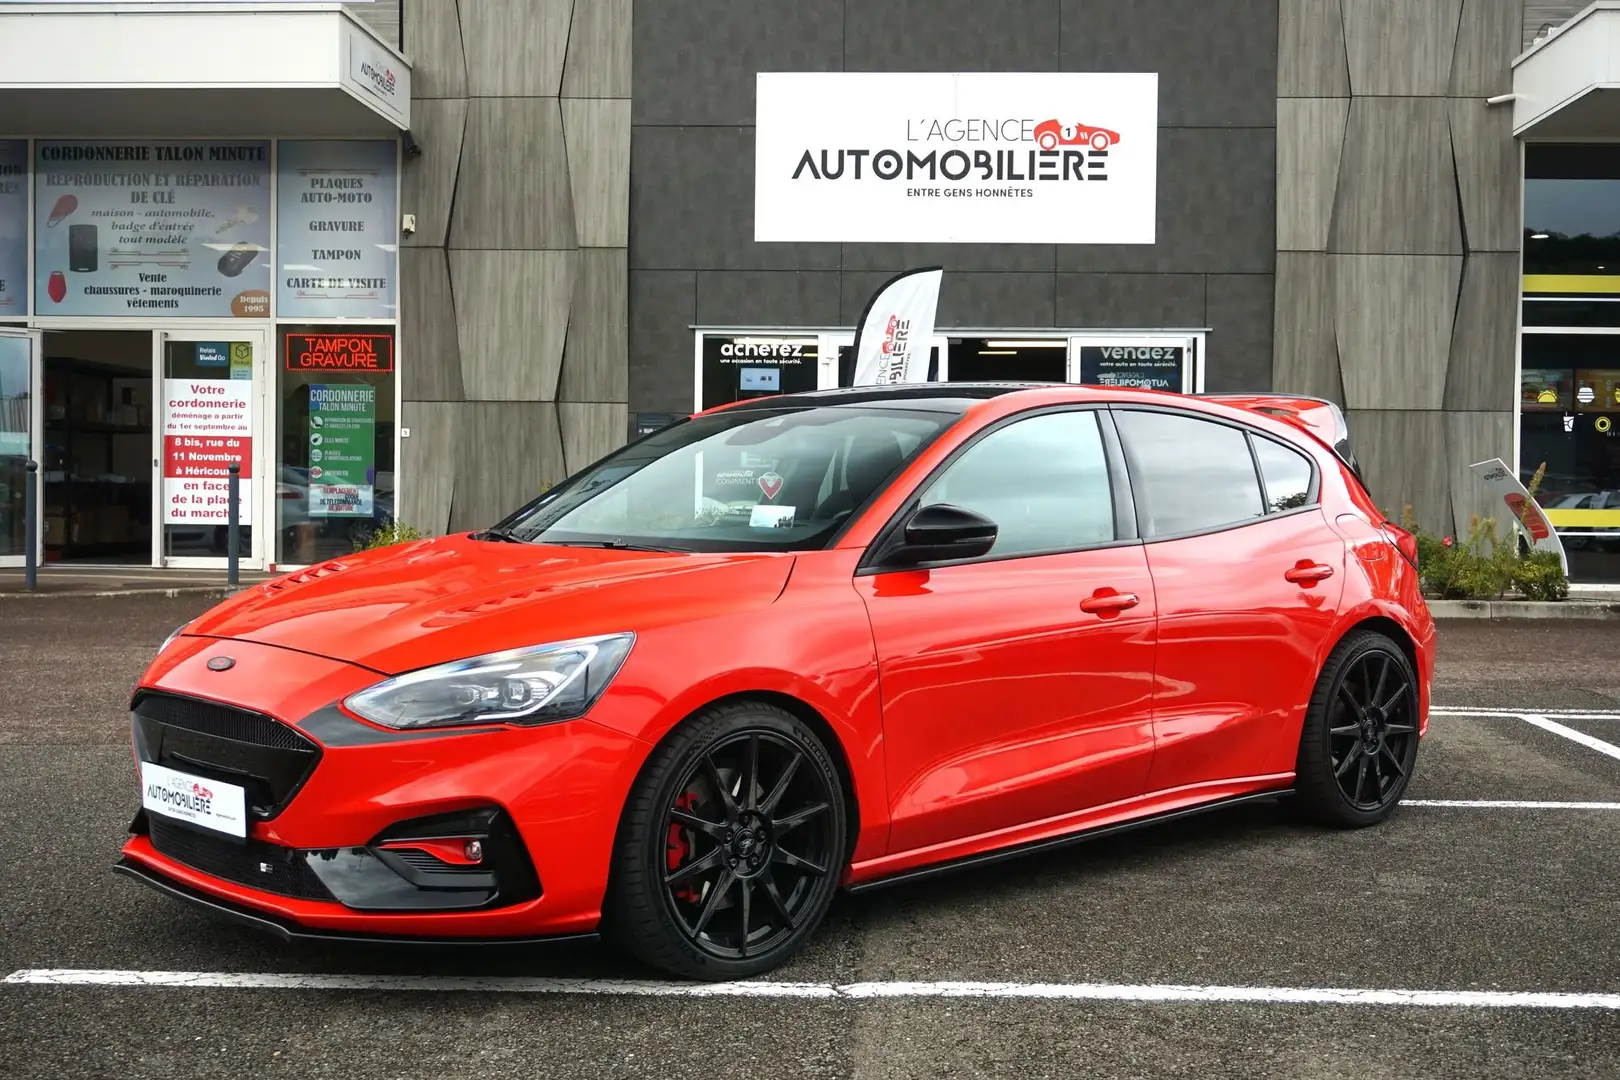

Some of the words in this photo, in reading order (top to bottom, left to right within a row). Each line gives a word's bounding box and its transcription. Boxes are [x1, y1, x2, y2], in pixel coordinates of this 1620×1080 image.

[907, 119, 1034, 142] L'AGENCE
[1065, 127, 1071, 137] 1
[42, 146, 150, 161] CORDONNERIE
[155, 146, 204, 161] TALON
[209, 146, 265, 161] MINUTE
[791, 149, 1108, 181] AUTOMOBILIERE
[46, 173, 150, 187] REPRODUCTION
[155, 173, 170, 187] ET
[175, 171, 260, 187] RÉPARATION
[311, 178, 363, 190] PLAQUES
[130, 191, 149, 204] DE
[153, 189, 175, 204] CLÉ
[907, 188, 941, 197] ENTRE
[944, 188, 973, 197] GENS
[976, 186, 1033, 197] HONNÊTES
[301, 192, 372, 203] AUTO-MOTO
[91, 209, 134, 217] maison
[145, 208, 215, 218] automobile,
[111, 222, 146, 233] badge
[149, 222, 195, 231] d'entrée
[309, 221, 364, 231] GRAVURE
[119, 236, 142, 244] tout
[145, 235, 187, 244] modèle
[312, 250, 361, 260] TAMPON
[139, 273, 167, 282] Vente
[287, 278, 325, 288] CARTE
[328, 278, 344, 288] DE
[348, 278, 386, 288] VISITE
[84, 286, 140, 295] chaussures
[150, 286, 222, 296] maroquinerie
[127, 298, 179, 308] vêtements
[240, 295, 268, 304] Depuis
[305, 338, 372, 352] TAMPON
[720, 337, 802, 357] achetez
[301, 353, 377, 367] GRAVURE
[191, 385, 225, 394] Votre
[311, 390, 374, 402] CORDONNERIE
[169, 399, 246, 408] cordonnerie
[319, 402, 340, 411] TALON
[341, 402, 366, 412] MINUTE
[172, 412, 212, 421] déménage
[221, 413, 243, 421] partir
[174, 437, 182, 447] 8
[184, 438, 203, 448] bis,
[227, 439, 240, 447] du
[173, 452, 185, 461] 11
[189, 453, 242, 462] Novembre
[176, 467, 182, 475] à
[185, 466, 230, 475] Héricour
[203, 481, 230, 490] face
[172, 494, 187, 504] de
[192, 494, 203, 504] la
[171, 508, 186, 518] du
